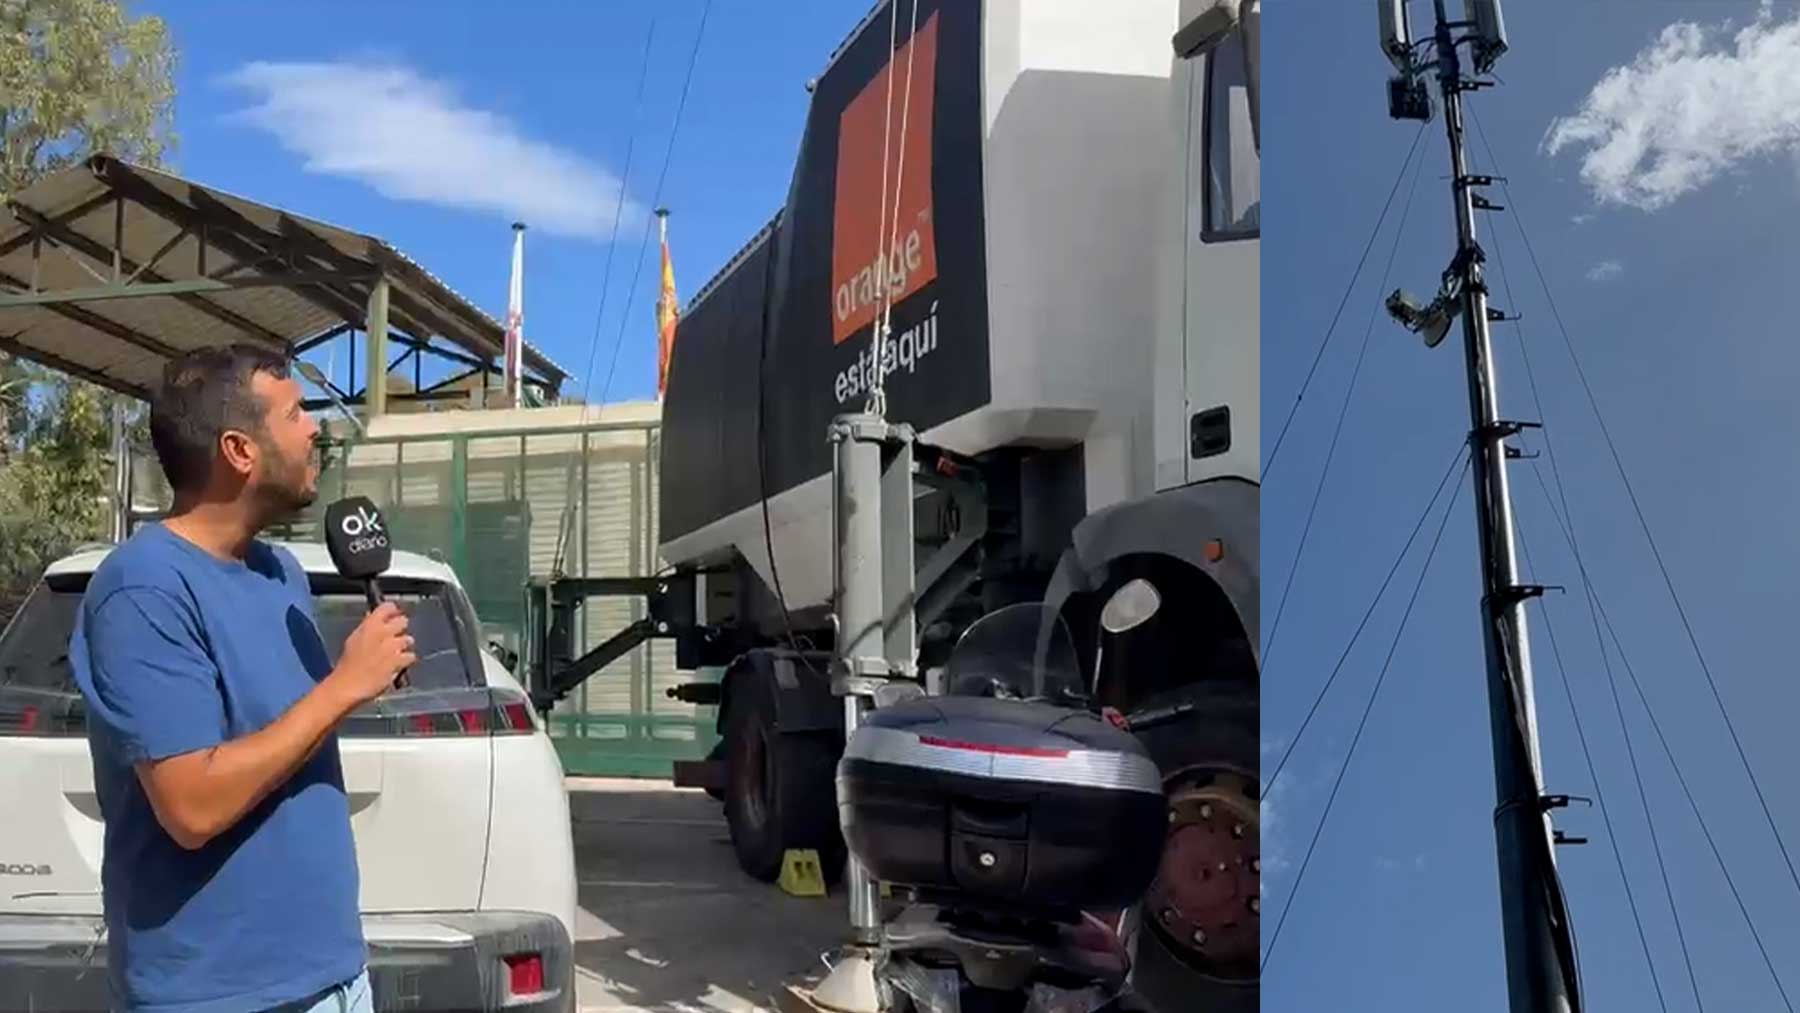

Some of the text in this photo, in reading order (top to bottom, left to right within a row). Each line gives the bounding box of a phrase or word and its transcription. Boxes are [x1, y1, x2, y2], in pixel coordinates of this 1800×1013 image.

[835, 229, 921, 321] orange
[880, 300, 938, 375] aquí
[342, 506, 382, 535] ok
[348, 535, 388, 554] diario
